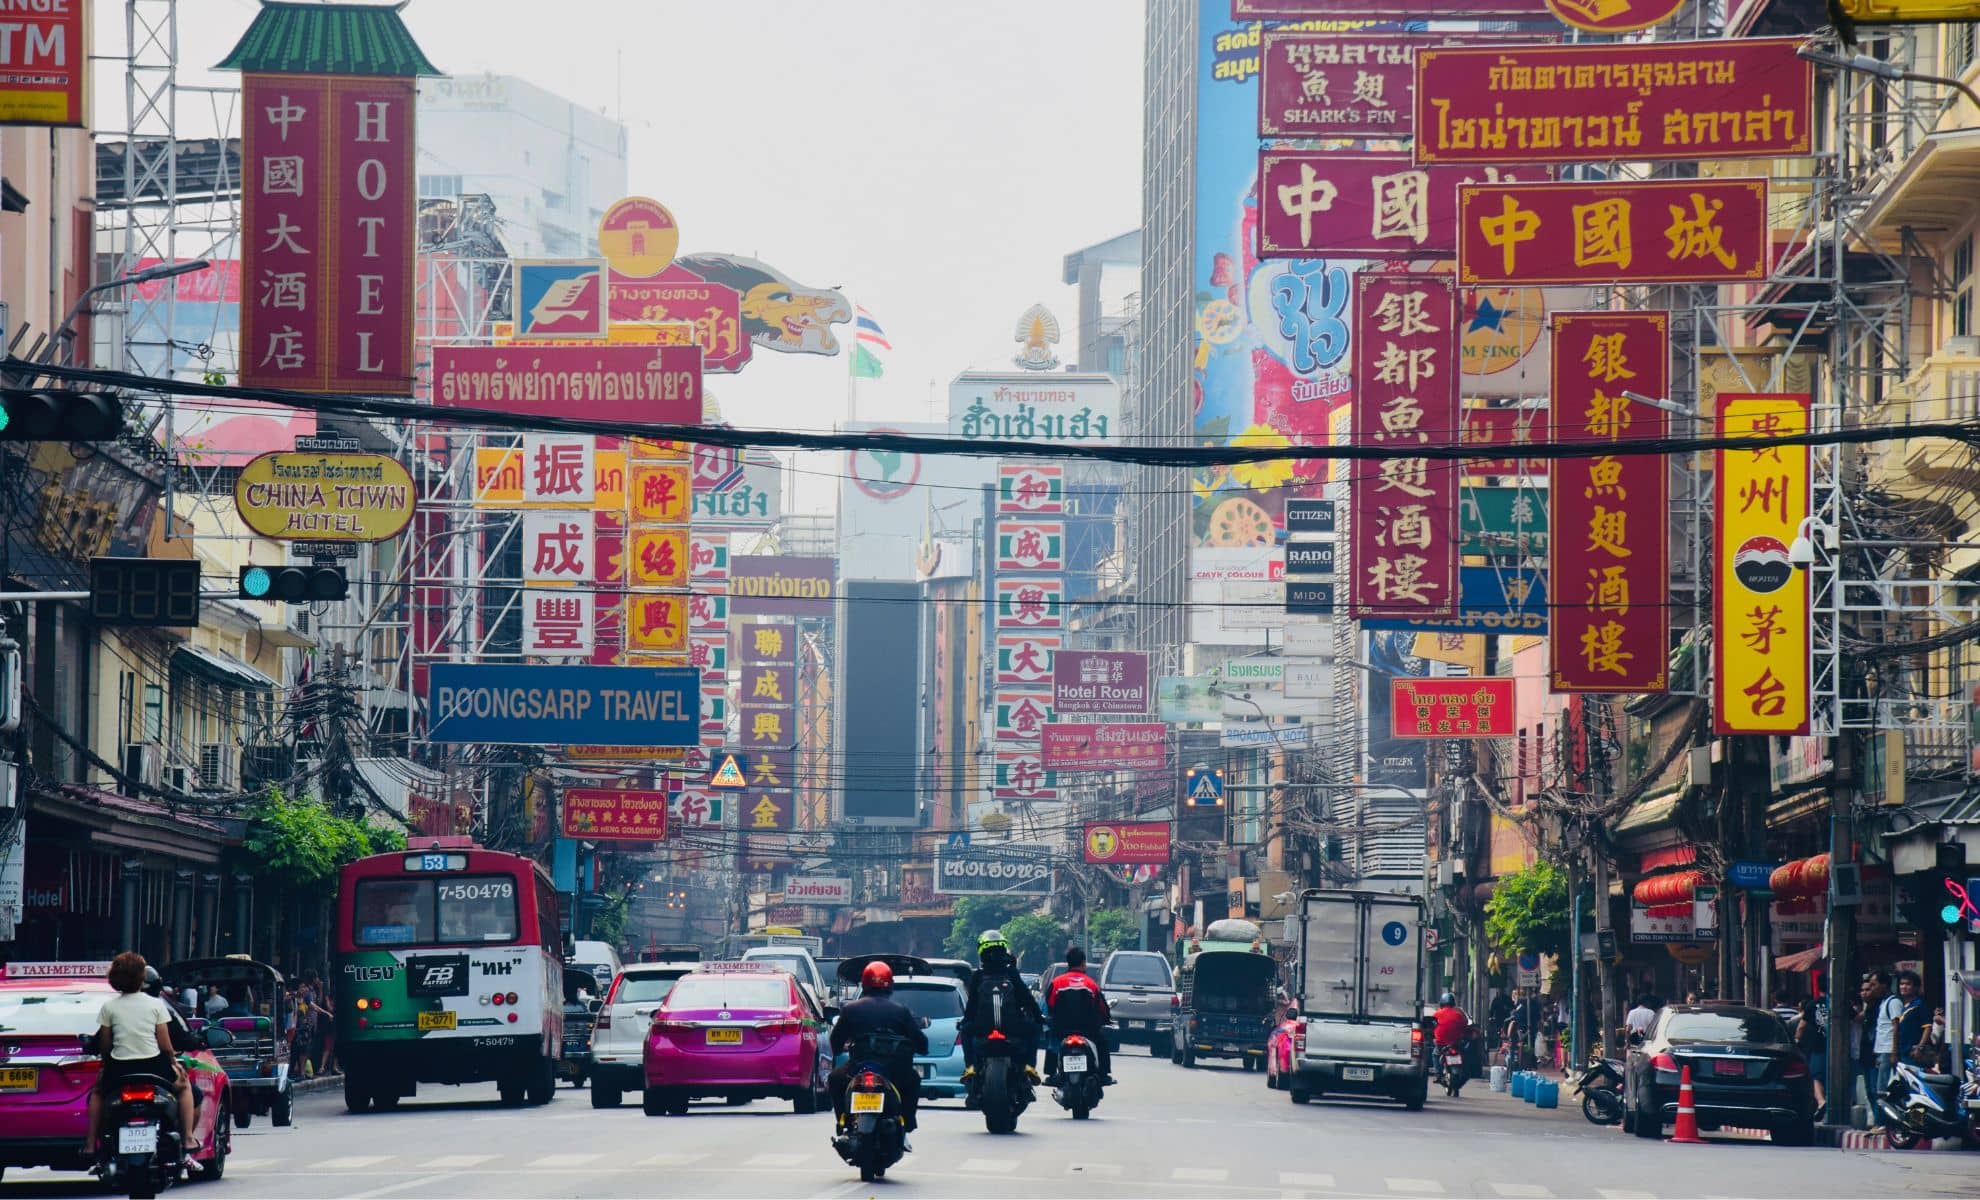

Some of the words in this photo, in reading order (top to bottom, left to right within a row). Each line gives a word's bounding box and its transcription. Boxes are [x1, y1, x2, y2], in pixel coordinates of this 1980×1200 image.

[1298, 71, 1388, 107] 魚翅
[1284, 109, 1359, 124] SHARK'S
[1367, 110, 1397, 124] FIN
[1663, 95, 1795, 146] สกาล่า
[1278, 163, 1516, 248] 中國
[259, 96, 310, 371] 中國大酒店
[355, 102, 390, 372] HOTEL
[1480, 194, 1737, 275] 中國城
[1482, 345, 1521, 358] SING
[441, 350, 693, 405] ร่งทรัพย์การท่องเที่ยว
[1368, 291, 1441, 605] 銀都魚翅酒樓
[246, 484, 327, 509] CHINA
[334, 487, 407, 509] TOWN
[1580, 333, 1637, 679] 銀都魚翅酒樓
[287, 513, 364, 533] HOTEL
[1289, 511, 1332, 520] CITIZEN
[533, 443, 584, 649] 振成豐
[1289, 551, 1332, 561] RADO
[1294, 592, 1326, 600] MIDO
[1009, 474, 1049, 793] 和成興大金行
[1740, 605, 1788, 717] 茅台
[1058, 685, 1096, 699] Hotel
[1101, 686, 1142, 700] Royal
[439, 688, 591, 722] ROONGSARP
[599, 690, 689, 722] TRAVEL
[1058, 702, 1090, 710] Bangkok
[1226, 729, 1281, 742] BROADWAY
[424, 856, 444, 870] 53
[27, 888, 62, 906] Hotel
[439, 884, 513, 900] 7-50479
[1393, 926, 1402, 941] 9
[1380, 966, 1394, 975] A9
